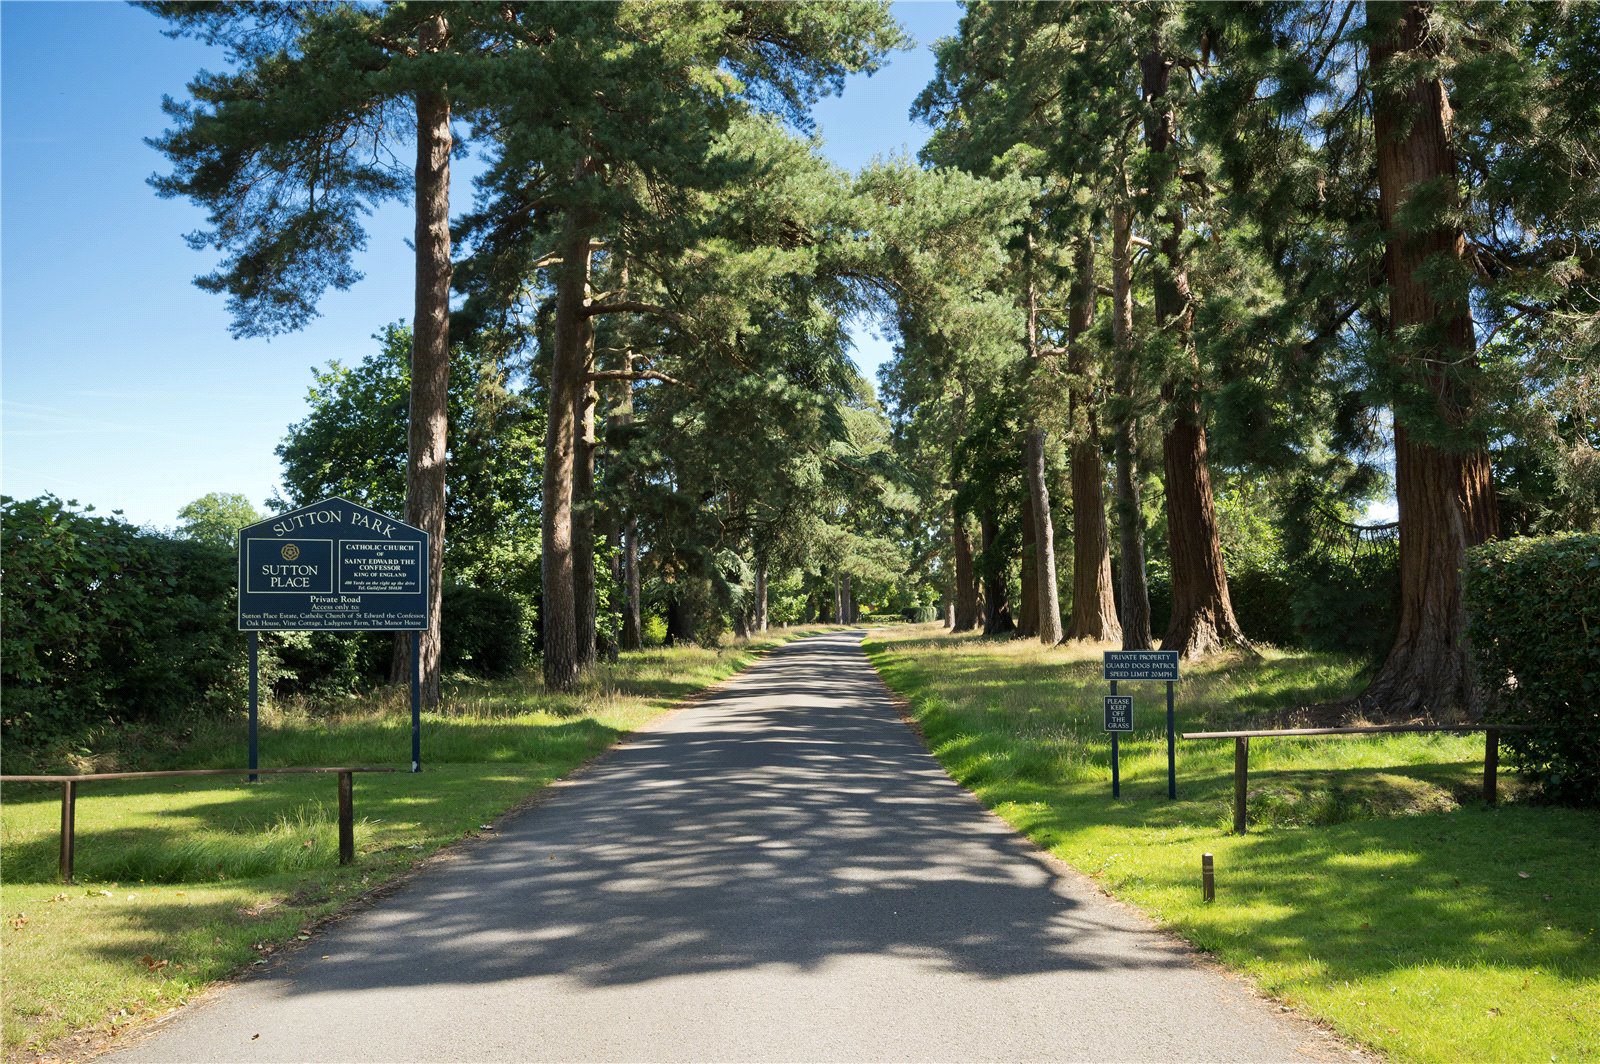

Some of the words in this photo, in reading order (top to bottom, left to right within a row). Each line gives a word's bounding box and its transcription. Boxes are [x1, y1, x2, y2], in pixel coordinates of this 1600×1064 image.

[273, 510, 342, 537] SUTTON
[351, 512, 397, 538] PARK
[262, 565, 318, 576] SUTTON
[271, 577, 310, 588] PLACE
